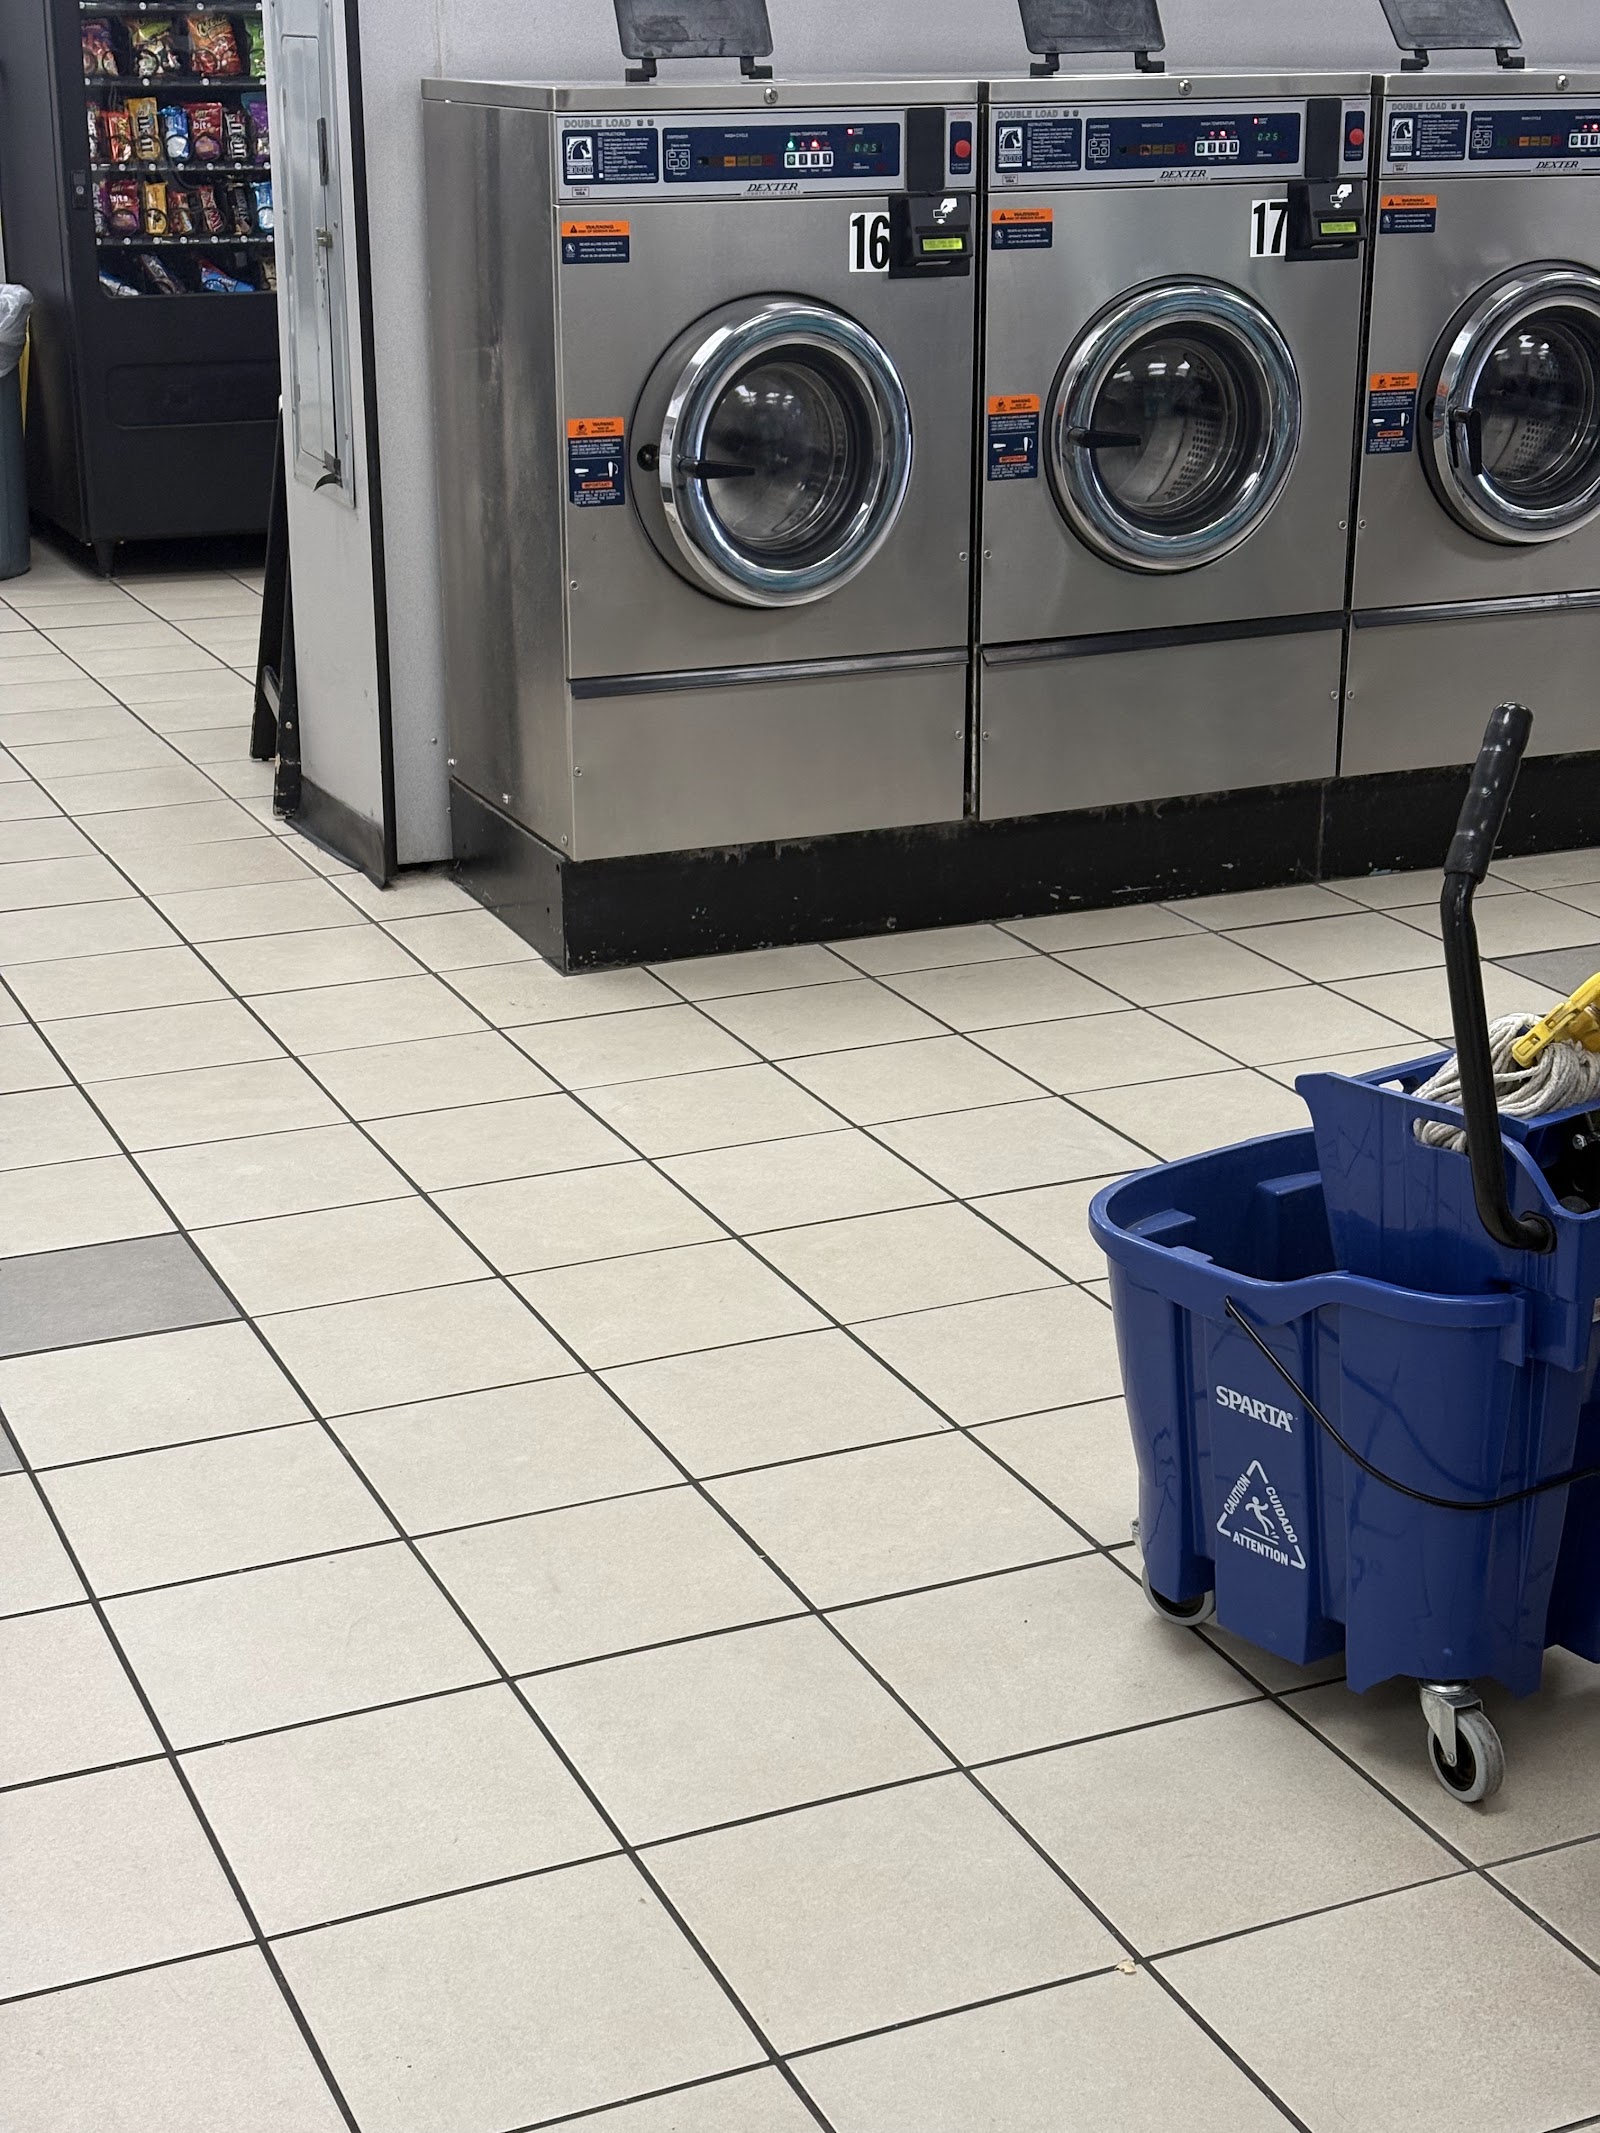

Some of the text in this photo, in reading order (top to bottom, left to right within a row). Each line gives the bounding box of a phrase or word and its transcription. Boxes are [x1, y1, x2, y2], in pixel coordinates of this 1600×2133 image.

[1392, 102, 1447, 110] DOUBLE LOAD
[998, 110, 1058, 119] DOUBLE LOAD
[564, 118, 631, 128] DOUBLE LOAD
[1536, 160, 1579, 169] DEXTER
[1160, 169, 1207, 178] DEXTER
[746, 182, 798, 192] DEXTER
[1254, 202, 1288, 254] 17
[852, 214, 890, 270] 16
[1223, 1473, 1251, 1515] CAUTION
[1265, 1486, 1298, 1544] CUIDADO
[1232, 1531, 1289, 1566] ATTENTION
